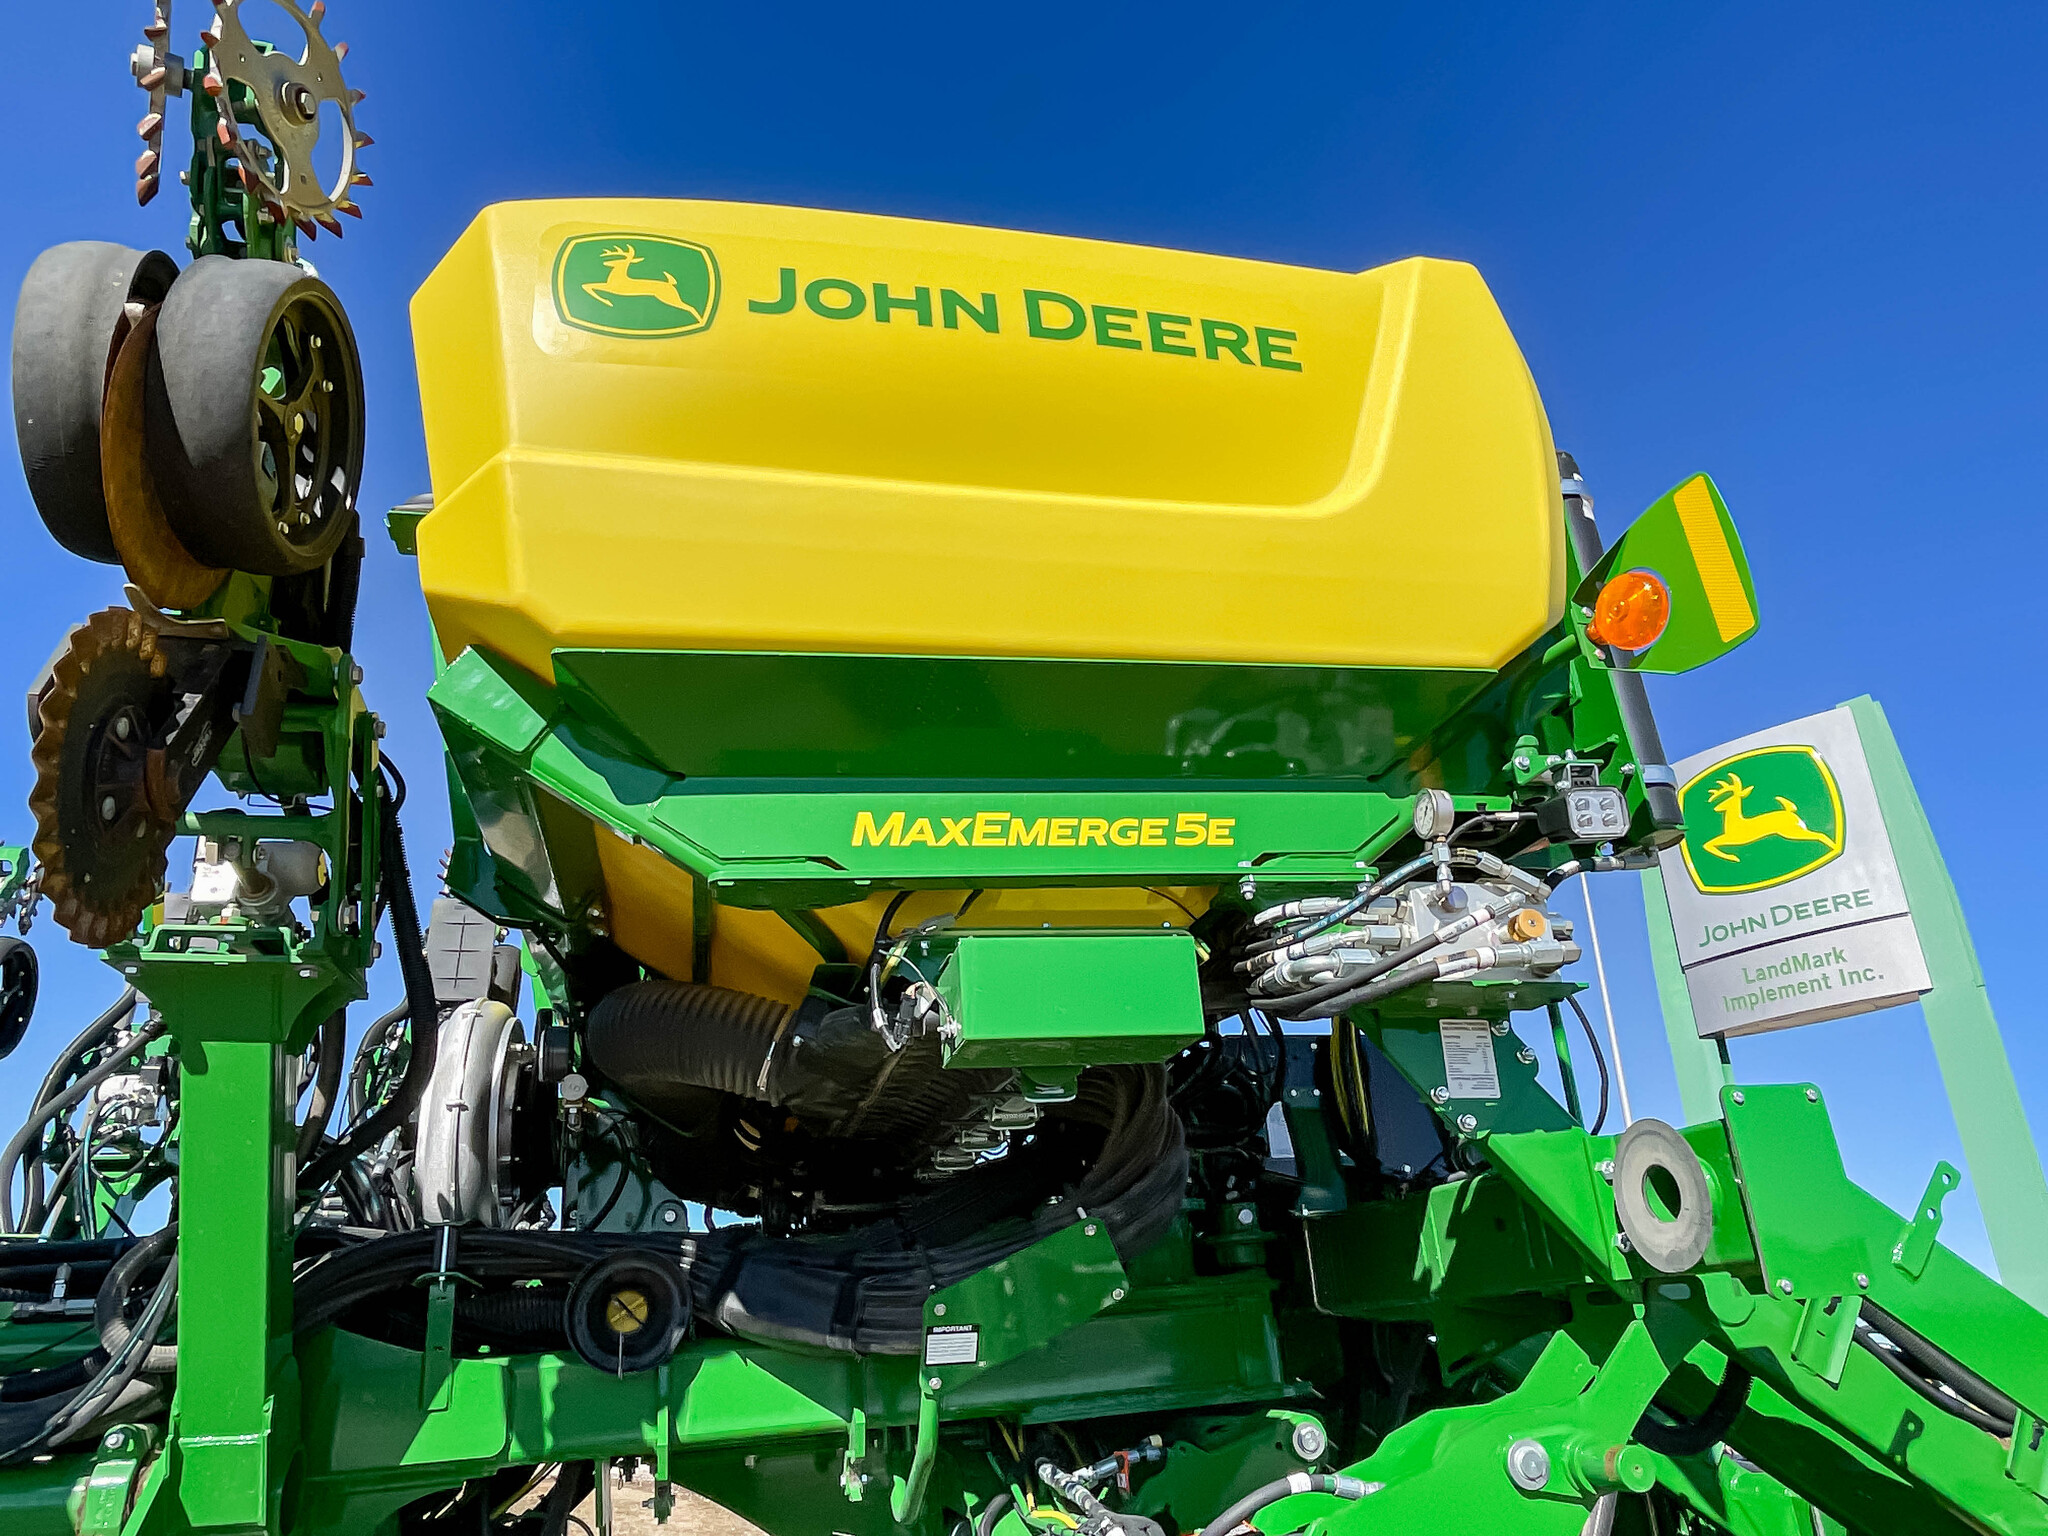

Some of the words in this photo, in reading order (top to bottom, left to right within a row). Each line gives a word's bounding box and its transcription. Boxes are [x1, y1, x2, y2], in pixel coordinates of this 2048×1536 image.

[748, 267, 1000, 334] JOHN
[1023, 289, 1304, 373] DEERE
[1174, 812, 1236, 847] 5E
[1699, 913, 1767, 947] JOHN
[1770, 889, 1873, 926] DEERE
[1742, 947, 1848, 984] LandMark
[1723, 973, 1832, 1012] Implement
[1838, 968, 1884, 986] Inc.
[933, 1325, 972, 1333] IMPORTANT
